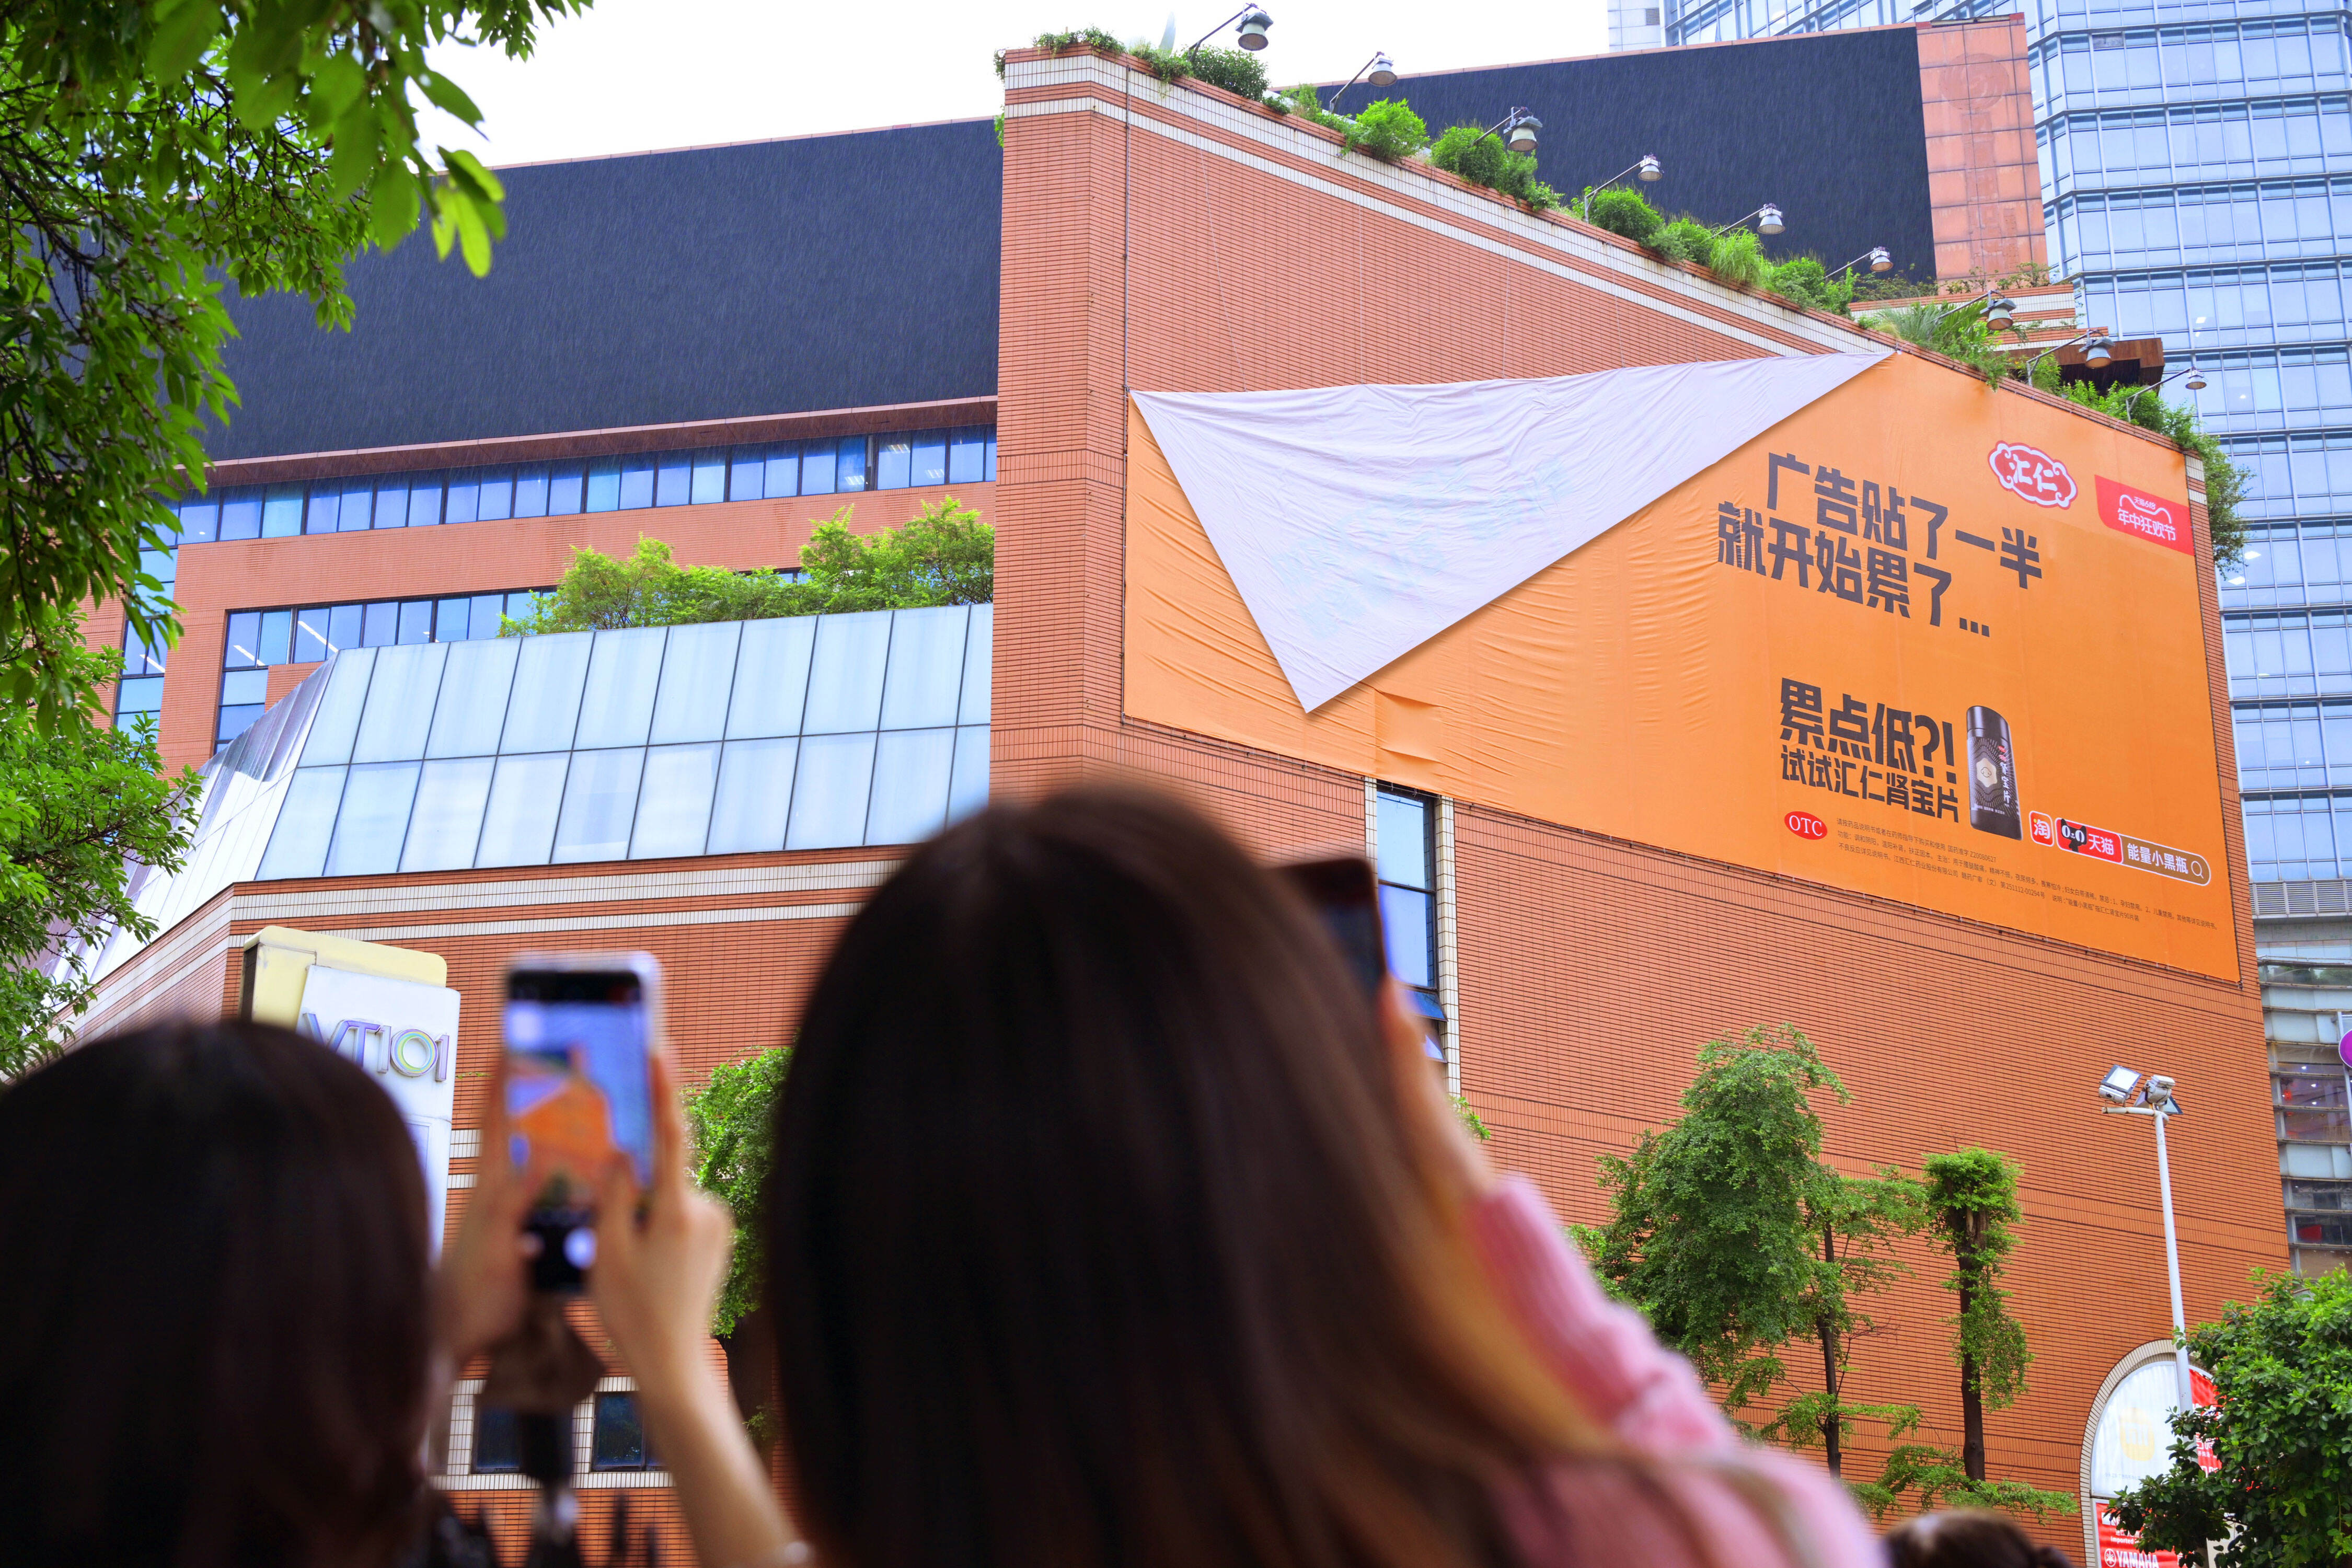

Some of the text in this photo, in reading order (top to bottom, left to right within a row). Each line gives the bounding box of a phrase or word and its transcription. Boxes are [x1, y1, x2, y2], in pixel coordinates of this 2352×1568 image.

[2009, 454, 2058, 492] 汇仁
[1767, 452, 2042, 589] 广告贴了一半
[2117, 508, 2176, 541] 年中狂欢节
[1780, 677, 1957, 783] 累点低?!
[1781, 745, 1959, 823] 试试汇仁肾宝片
[1789, 815, 1823, 836] OTC
[2033, 818, 2050, 840] 淘
[2088, 833, 2114, 856] 天猫
[2126, 843, 2189, 875] 能量小黑瓶
[2116, 1550, 2159, 1568] YAMAHA
